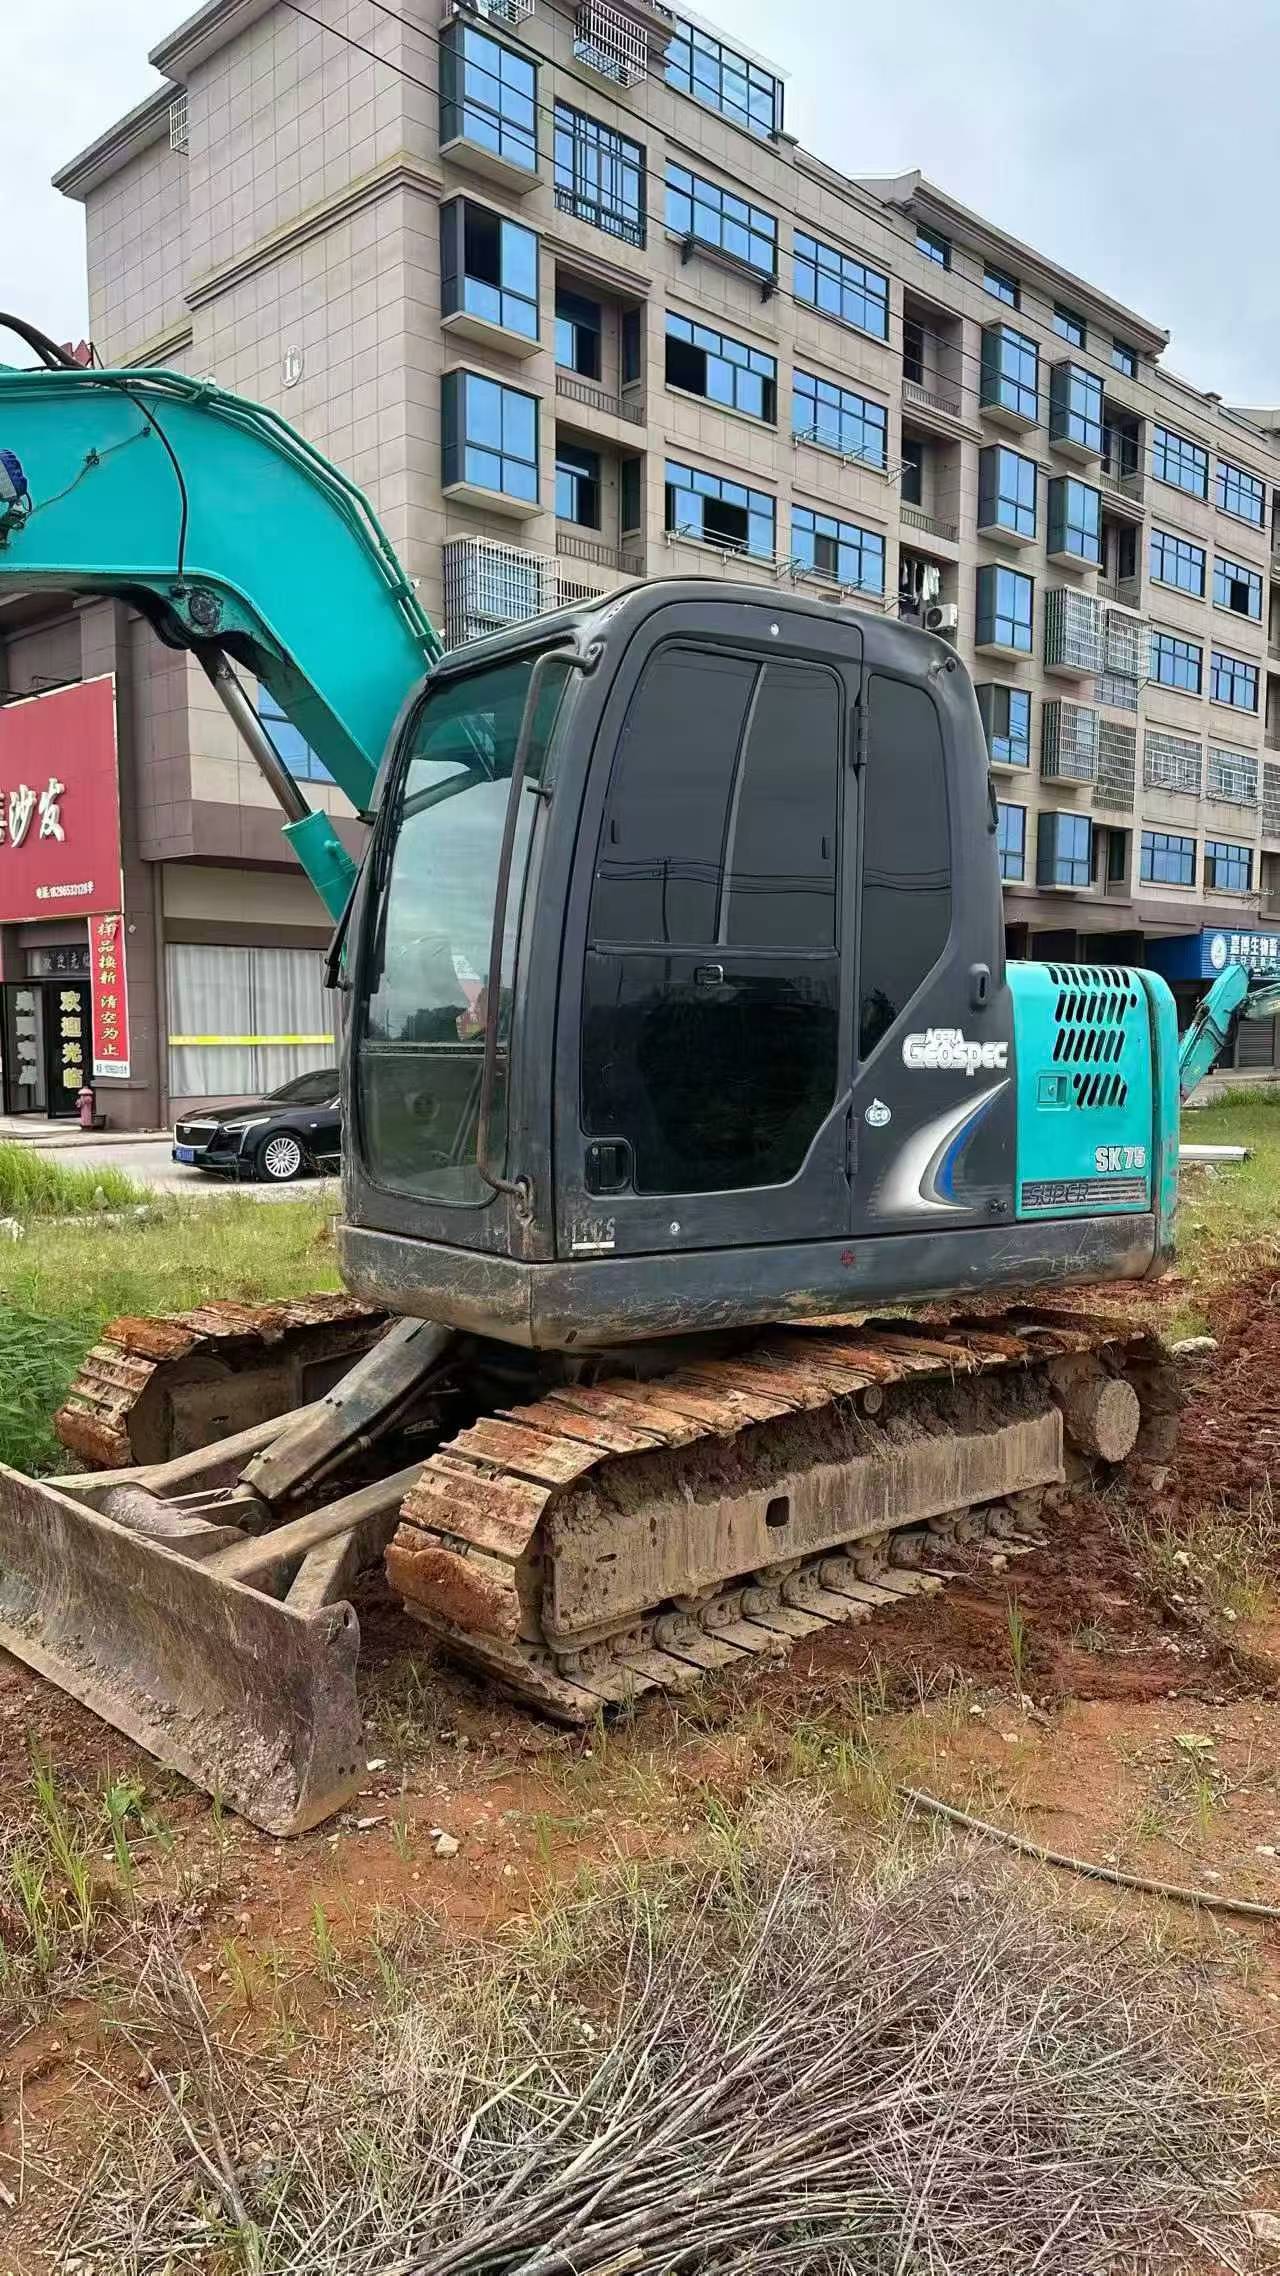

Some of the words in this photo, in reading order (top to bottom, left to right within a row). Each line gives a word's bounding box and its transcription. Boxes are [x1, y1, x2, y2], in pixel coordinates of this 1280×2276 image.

[59, 990, 84, 1088] 欢迎光临
[869, 1111, 888, 1122] ECO
[1028, 1183, 1089, 1206] SUPER
